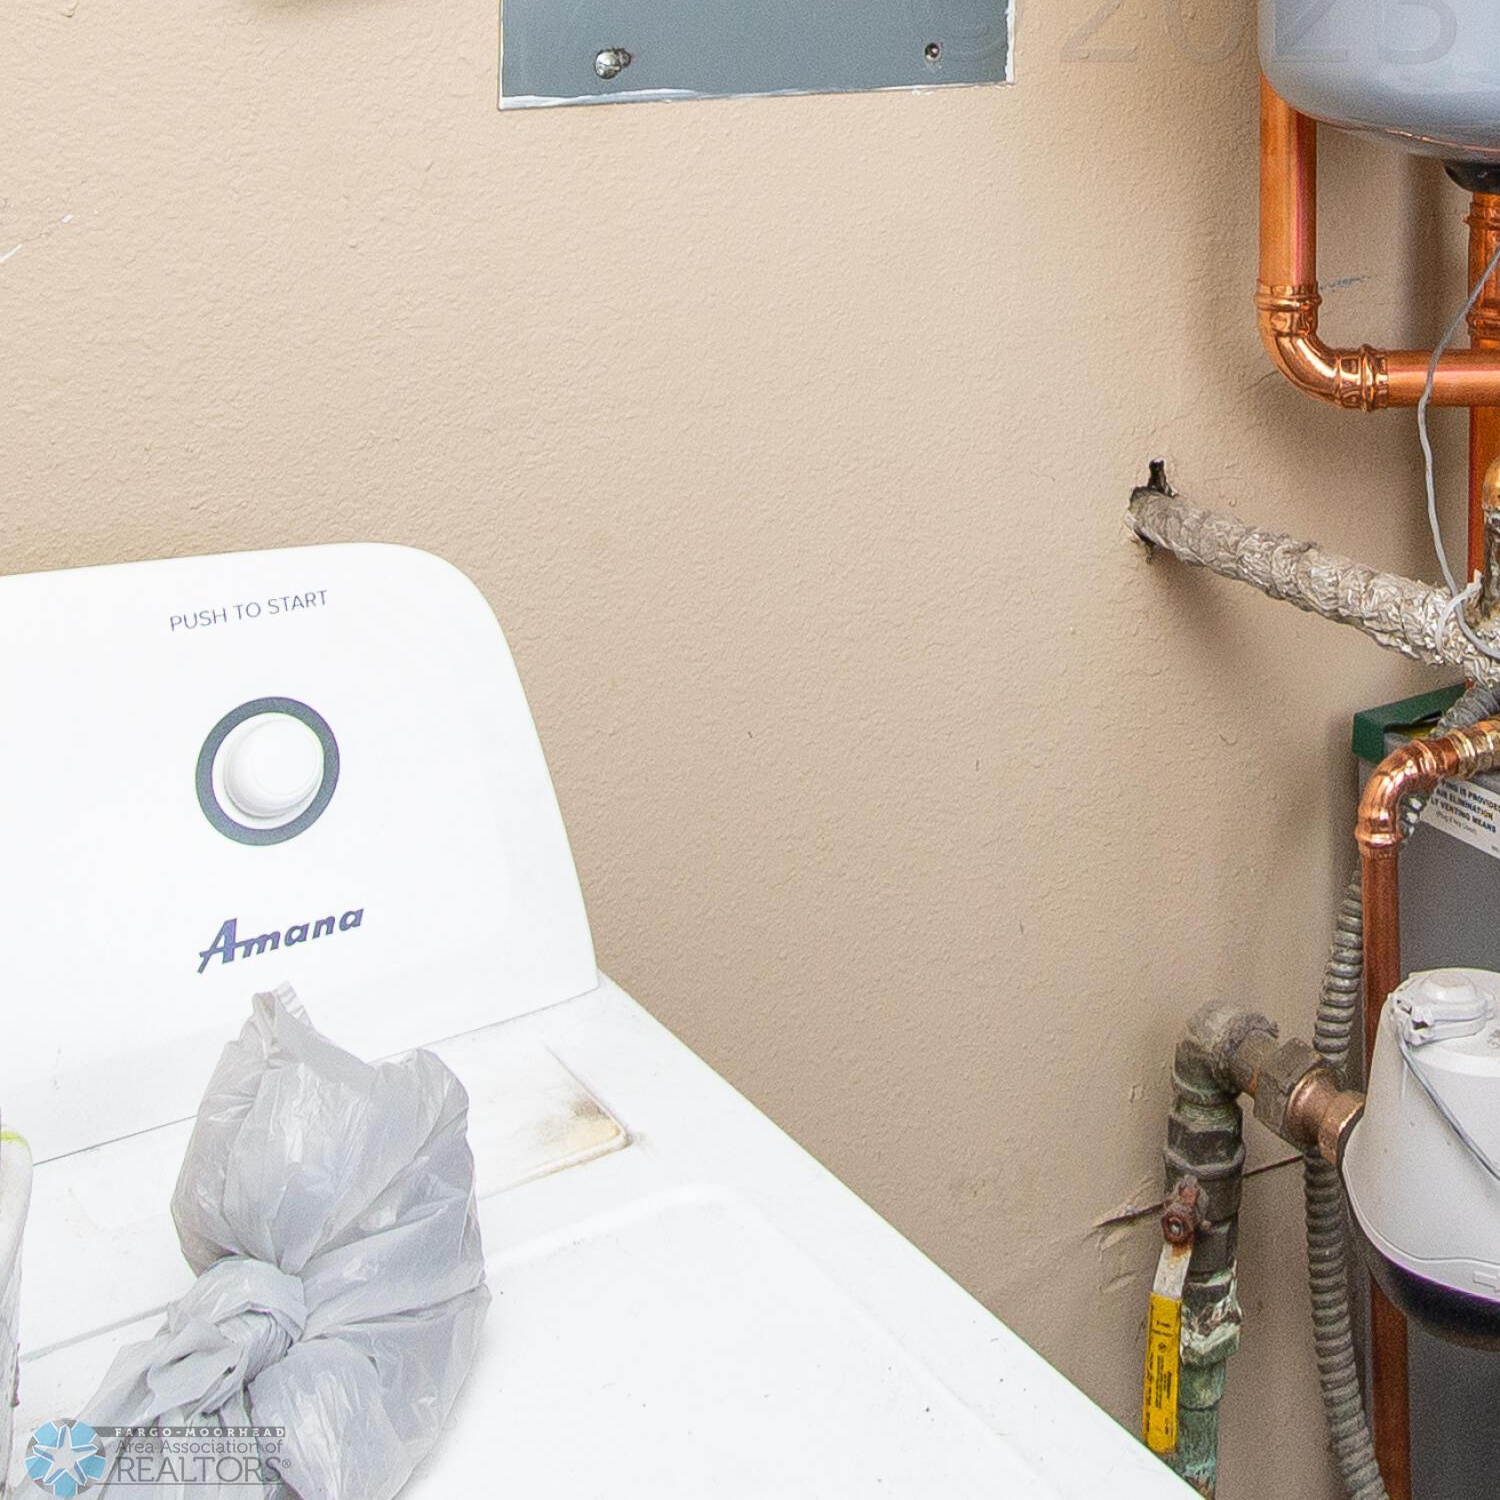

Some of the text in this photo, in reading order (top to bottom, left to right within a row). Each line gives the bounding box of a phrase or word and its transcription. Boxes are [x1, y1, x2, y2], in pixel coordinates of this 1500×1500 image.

[170, 589, 329, 632] PUSH TO START
[1471, 815, 1496, 834] MEANS
[197, 907, 365, 975] Amana
